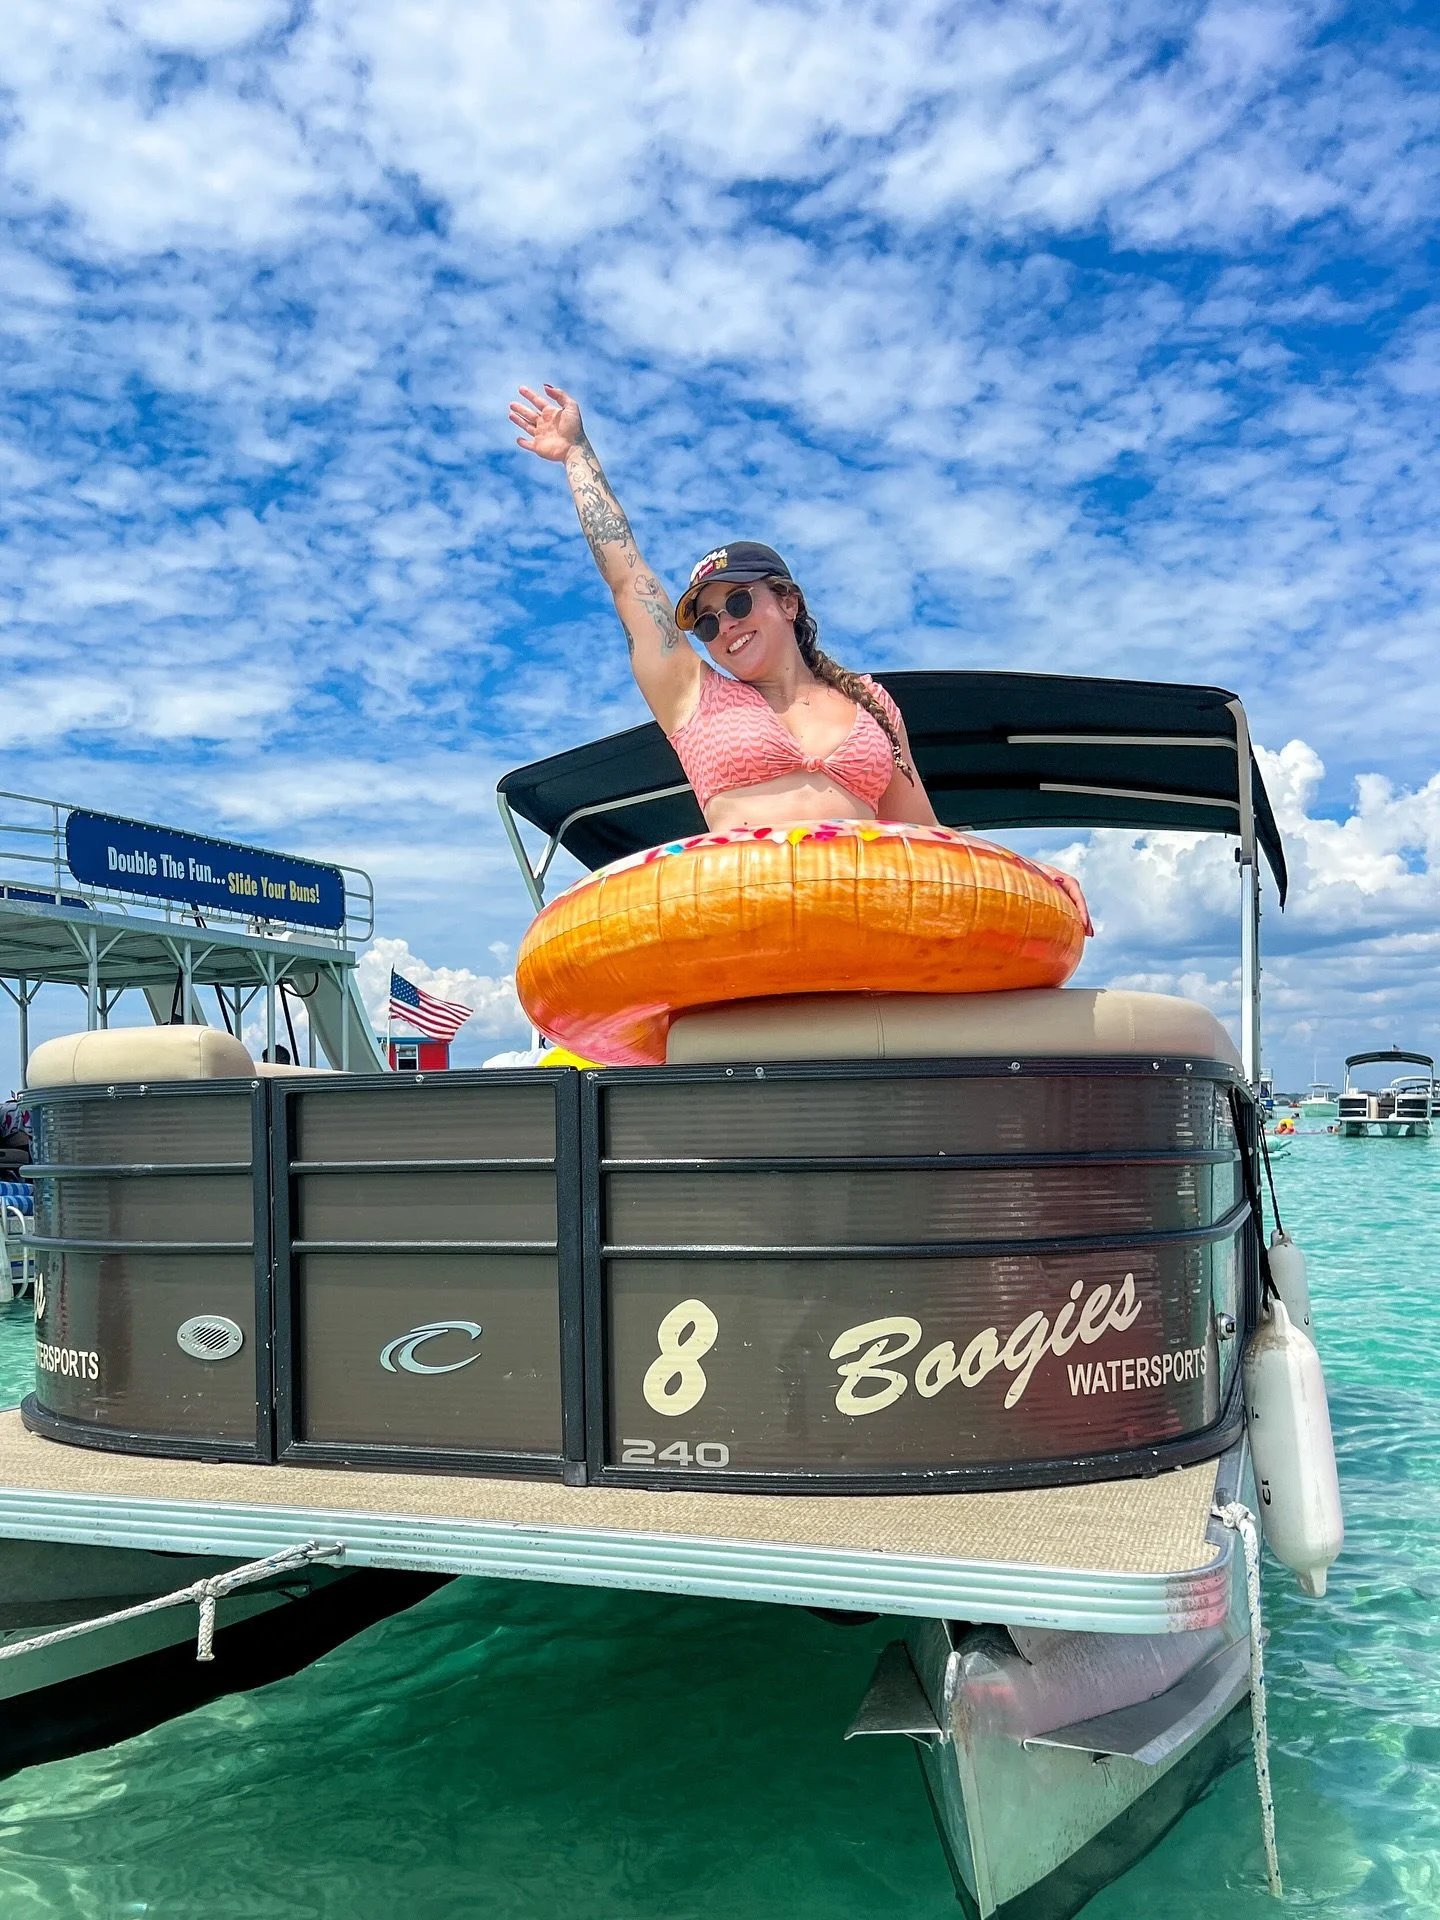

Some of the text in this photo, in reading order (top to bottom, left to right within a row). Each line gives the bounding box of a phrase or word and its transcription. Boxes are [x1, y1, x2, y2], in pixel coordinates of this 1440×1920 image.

[107, 846, 320, 904] Double The Fun... Slide Your Buns!
[643, 1299, 718, 1416] 8
[829, 1272, 1142, 1416] Boogies
[1066, 1345, 1207, 1396] WATERSPORTS
[621, 1438, 730, 1466] 240
